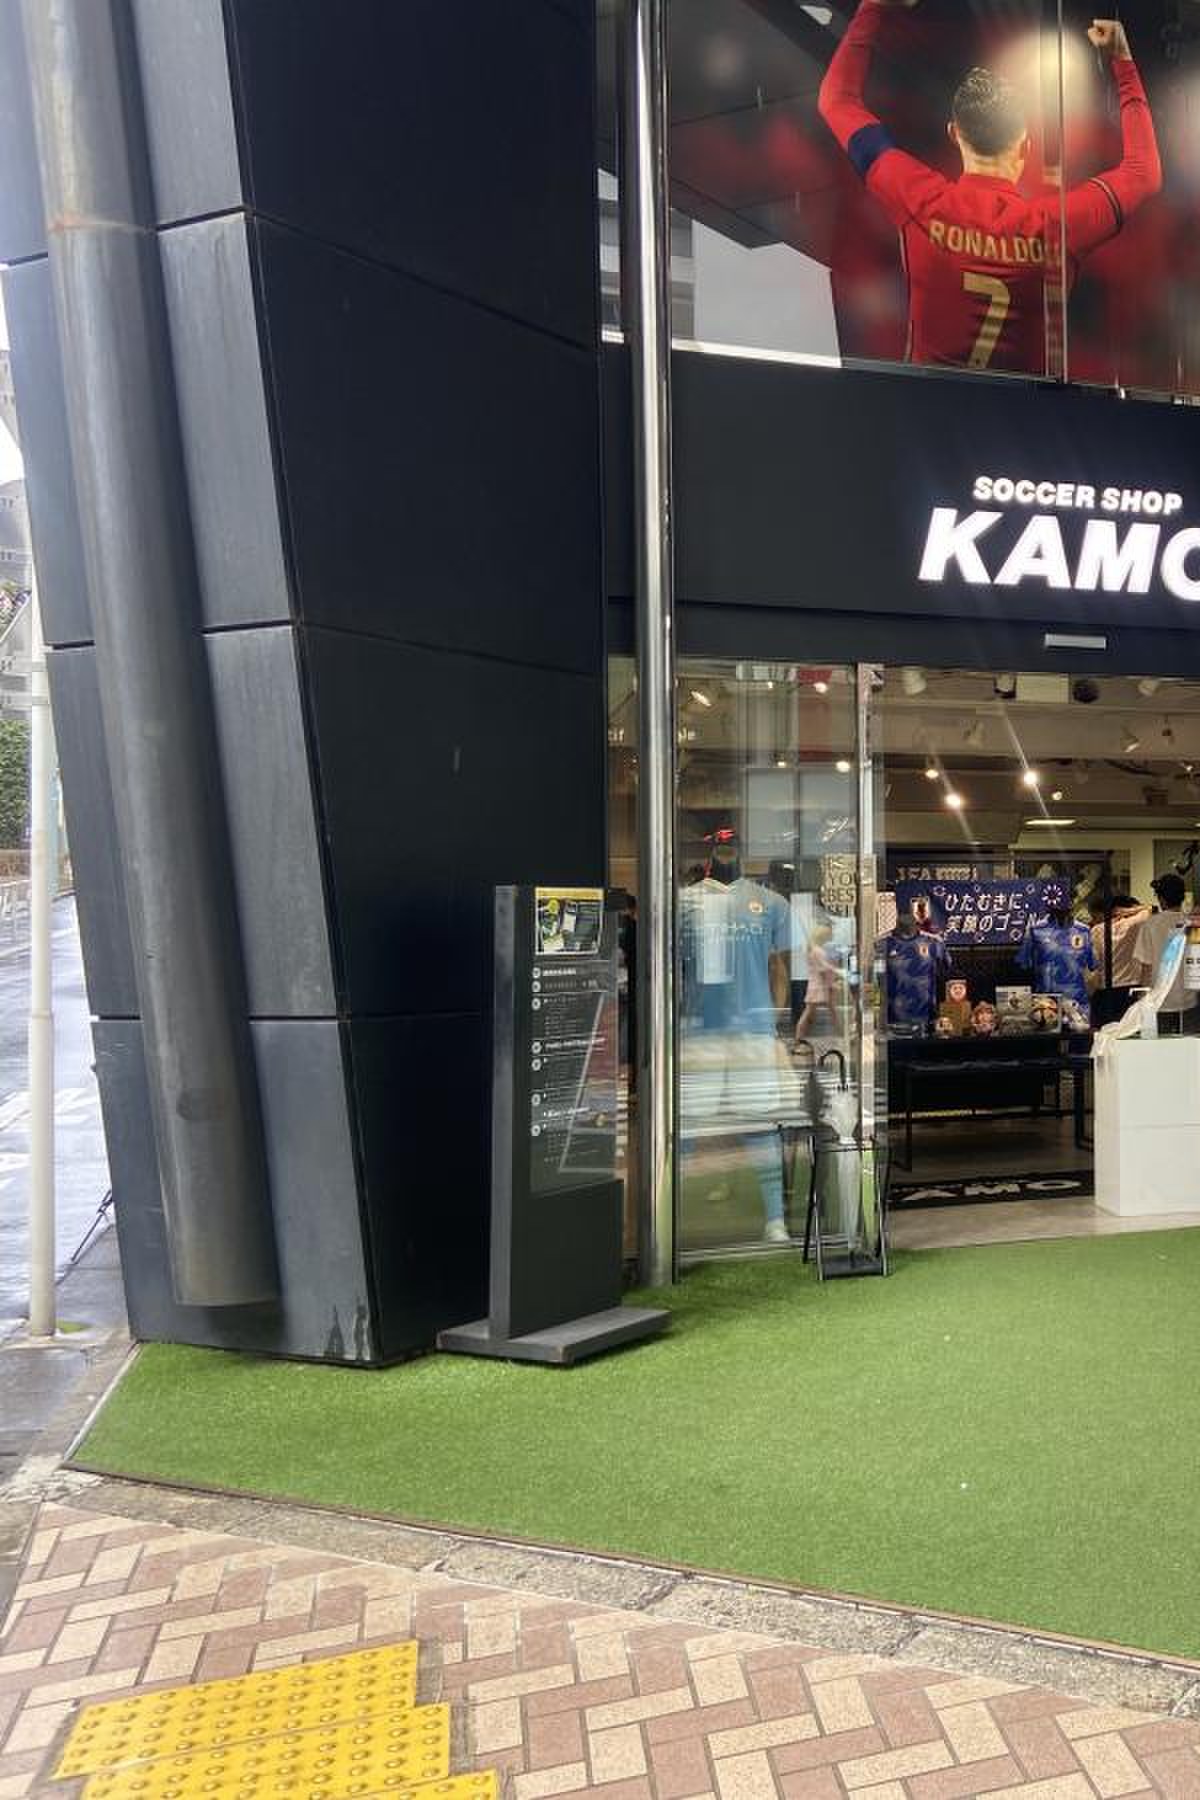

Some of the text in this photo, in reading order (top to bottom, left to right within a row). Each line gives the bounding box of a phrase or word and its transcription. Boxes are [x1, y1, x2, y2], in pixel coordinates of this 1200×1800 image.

[929, 218, 1043, 264] RONALDO
[963, 271, 1011, 369] 7
[972, 475, 1184, 516] SOCCER SHOP
